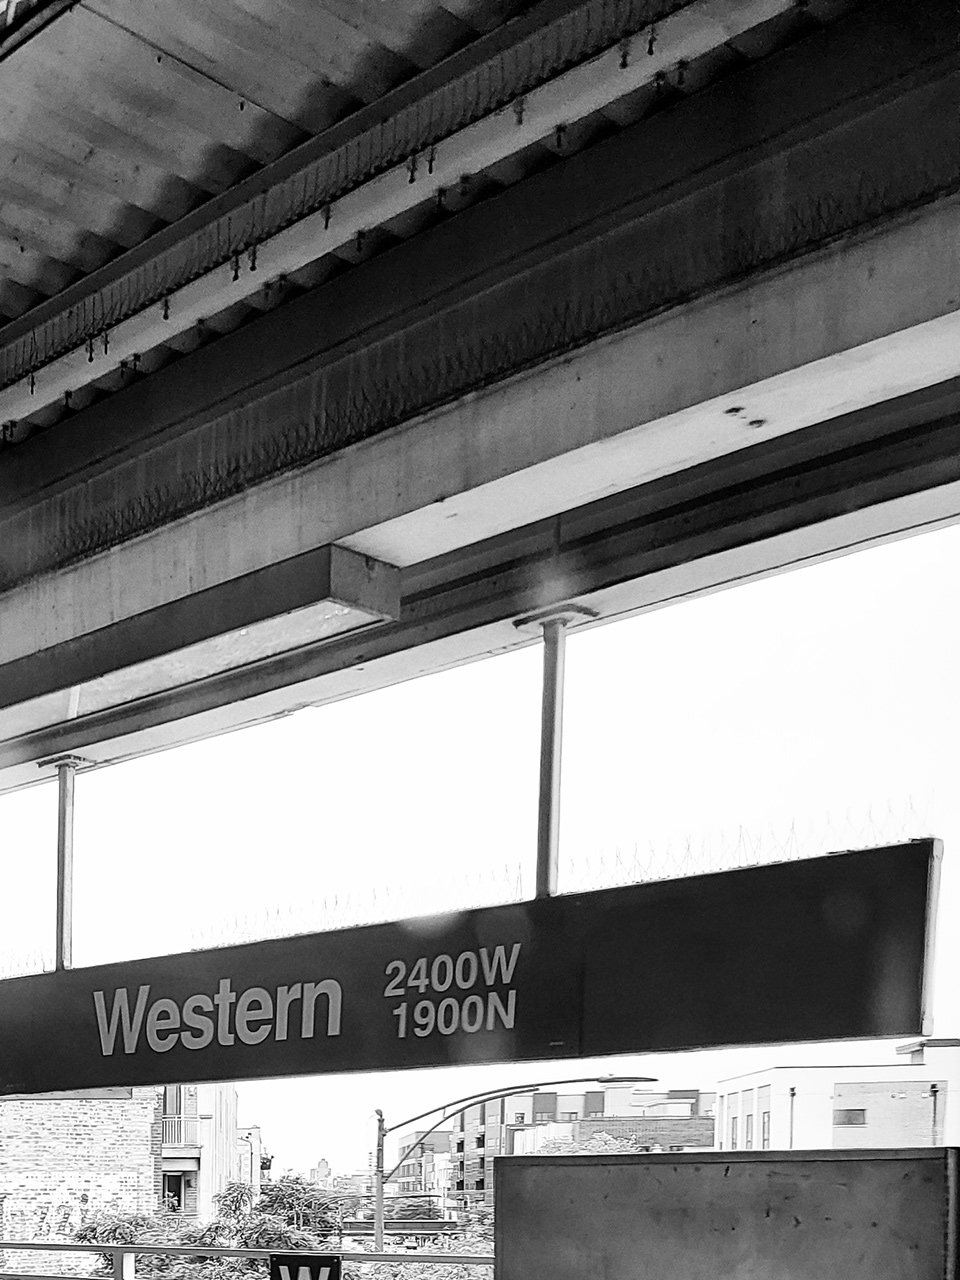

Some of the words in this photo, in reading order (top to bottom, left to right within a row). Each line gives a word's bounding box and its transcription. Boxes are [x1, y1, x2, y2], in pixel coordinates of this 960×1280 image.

[384, 943, 521, 997] 2400W
[93, 978, 342, 1056] Western
[392, 989, 517, 1039] 1900N
